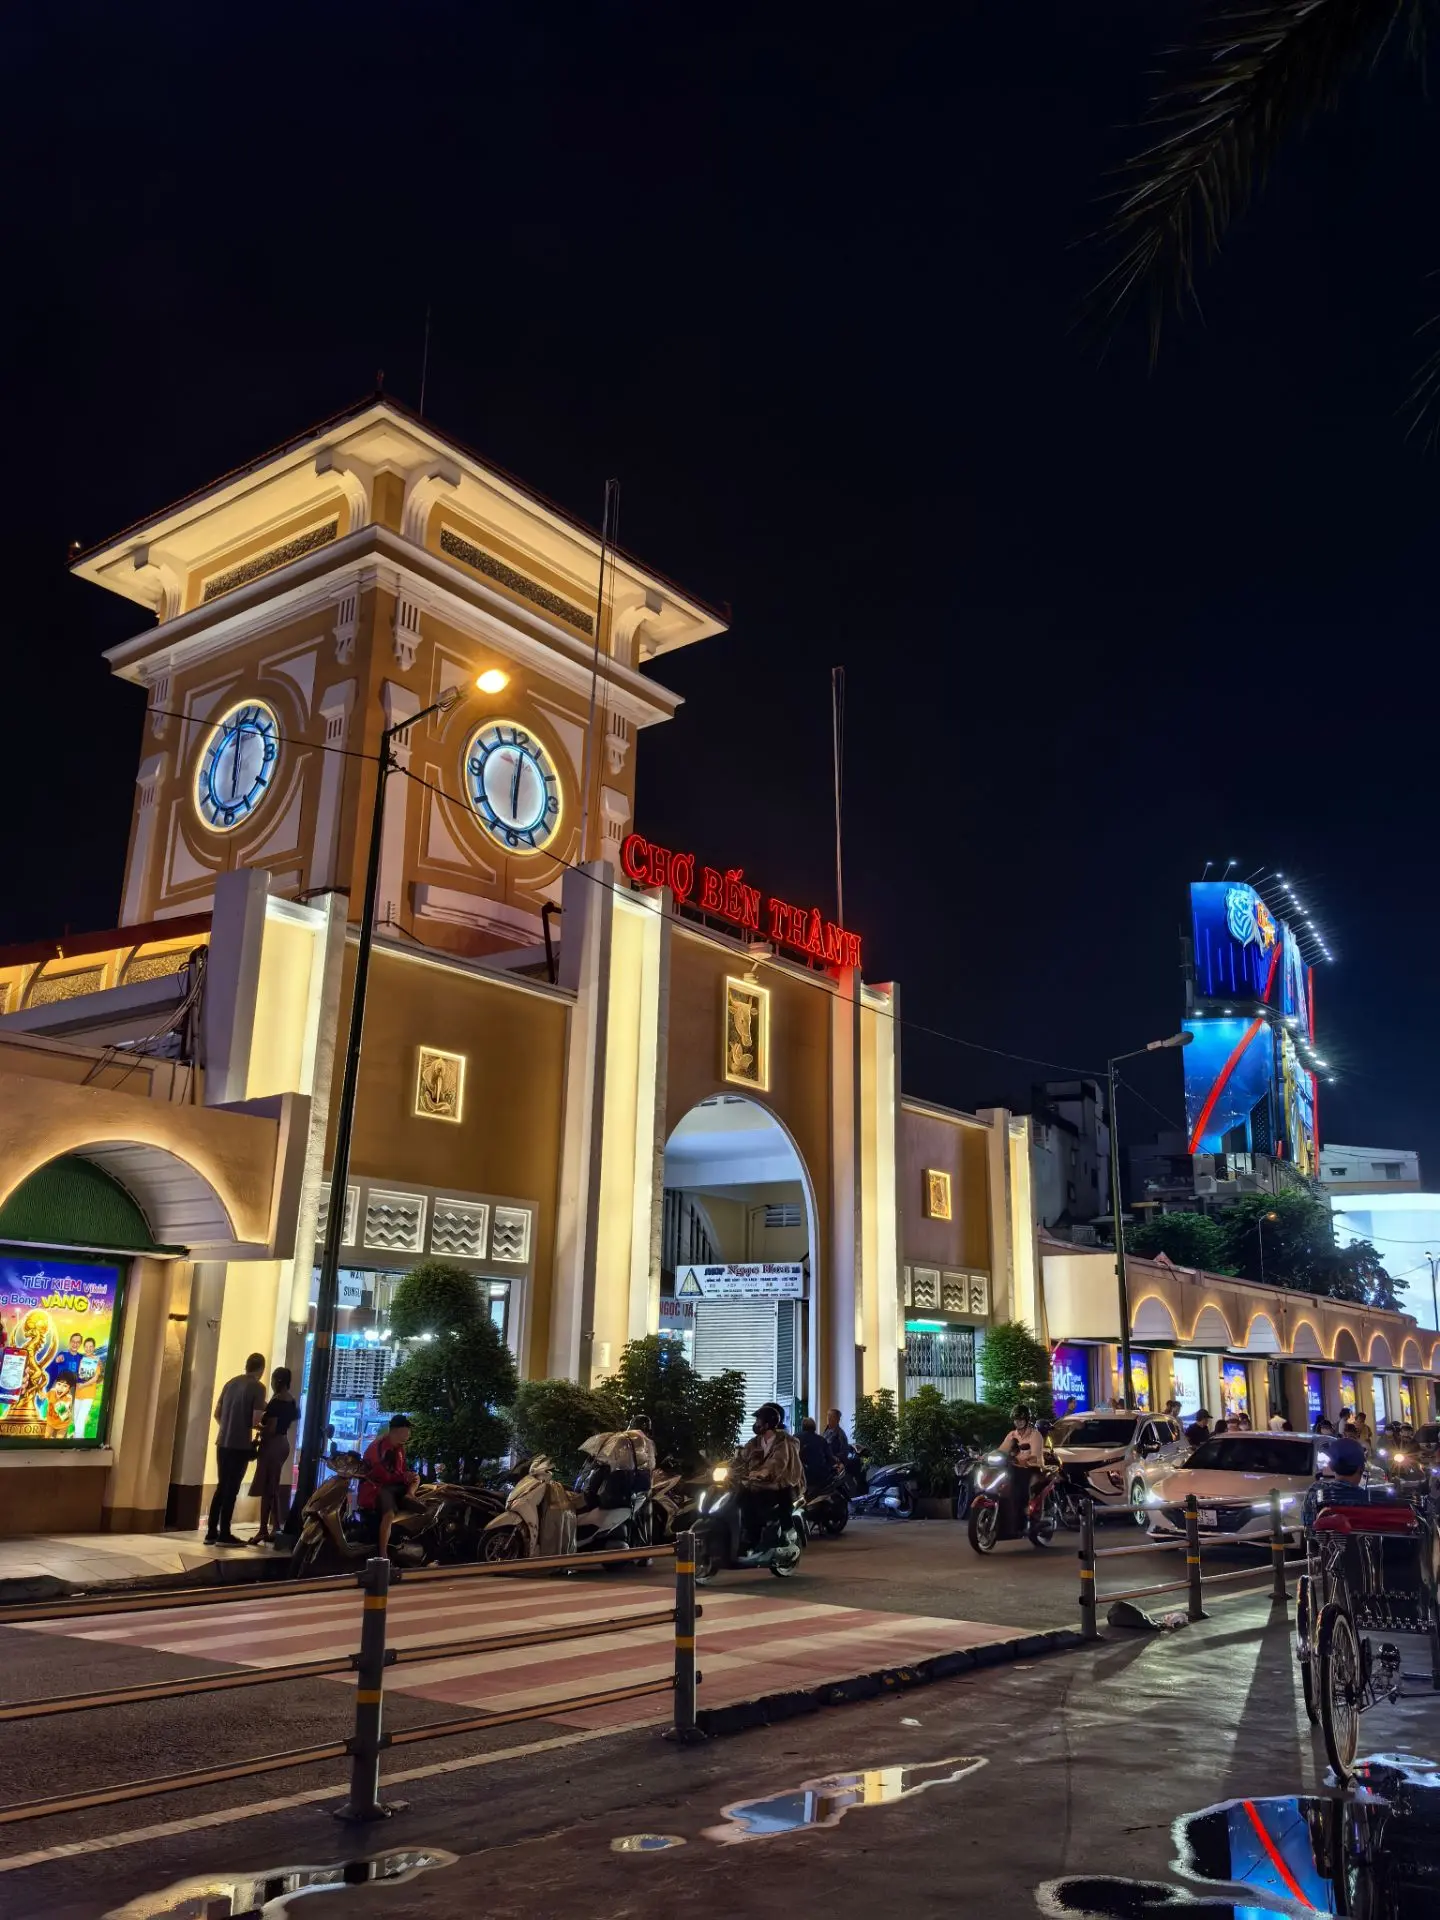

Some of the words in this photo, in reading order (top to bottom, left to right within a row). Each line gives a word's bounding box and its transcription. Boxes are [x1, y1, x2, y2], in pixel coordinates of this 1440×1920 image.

[621, 834, 695, 903] CHỢ
[702, 867, 761, 930] BẾN
[768, 898, 862, 969] THÀNH
[22, 1271, 50, 1288] TIẾT
[50, 1275, 82, 1292] KIỆM
[41, 1290, 89, 1312] VÀNG
